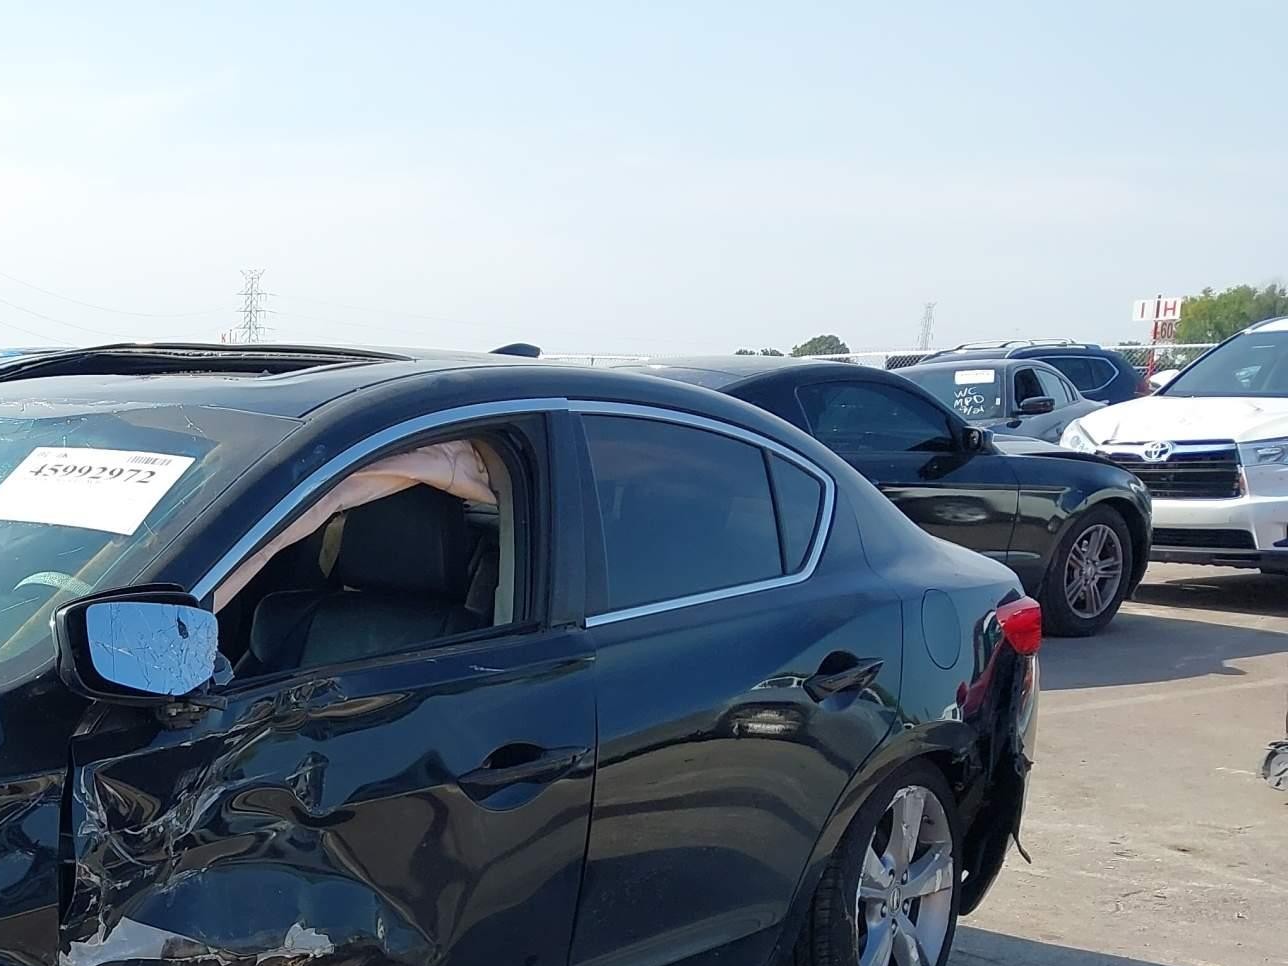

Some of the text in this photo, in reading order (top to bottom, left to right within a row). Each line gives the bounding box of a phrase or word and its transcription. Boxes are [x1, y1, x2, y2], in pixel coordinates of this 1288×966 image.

[1163, 300, 1177, 317] H
[953, 386, 977, 399] WC
[29, 463, 157, 484] 45992972
